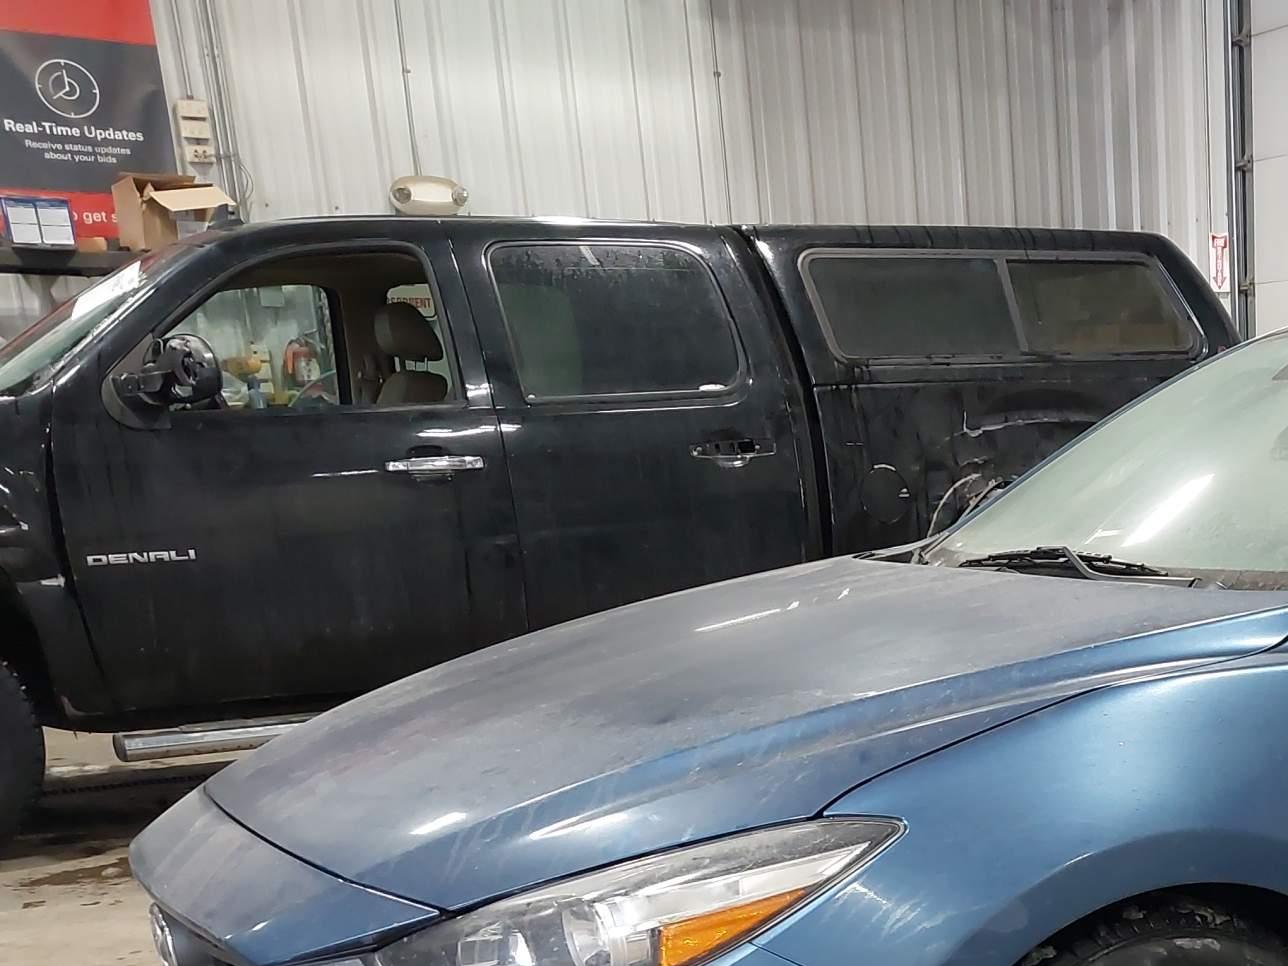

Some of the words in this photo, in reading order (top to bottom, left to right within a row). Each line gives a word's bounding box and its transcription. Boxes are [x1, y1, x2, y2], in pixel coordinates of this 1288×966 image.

[3, 118, 81, 137] Real-Time
[83, 125, 145, 142] Updates
[24, 138, 63, 151] Receive
[64, 142, 93, 153] status
[94, 145, 132, 155] updates
[44, 151, 72, 161] about
[73, 153, 96, 163] your
[96, 154, 118, 164] bids
[82, 210, 108, 225] get
[86, 548, 197, 567] DENALI
